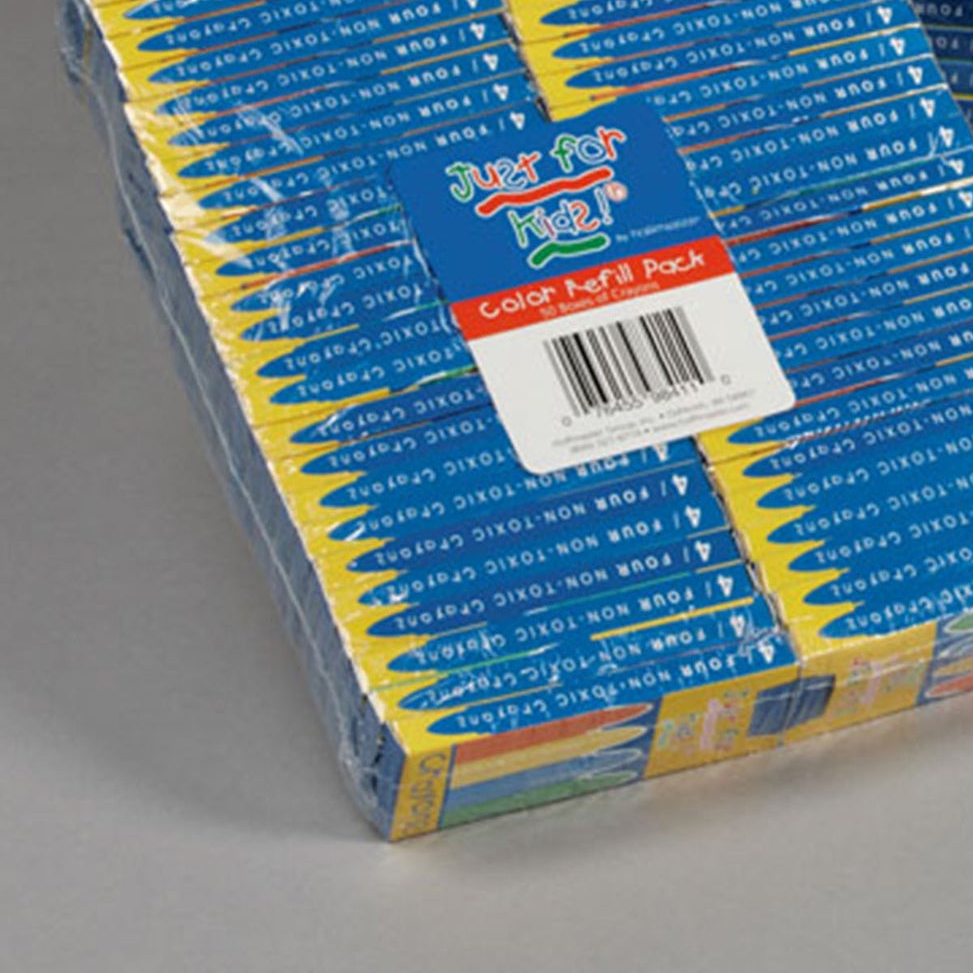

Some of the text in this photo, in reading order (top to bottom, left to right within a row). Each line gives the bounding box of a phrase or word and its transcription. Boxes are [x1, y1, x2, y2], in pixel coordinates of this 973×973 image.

[388, 2, 441, 24] FOUR
[803, 17, 855, 37] FOUR
[445, 126, 627, 202] Just for
[479, 248, 705, 319] Color Refill Pack
[594, 486, 649, 510] FOUR
[616, 552, 672, 577] FOUR
